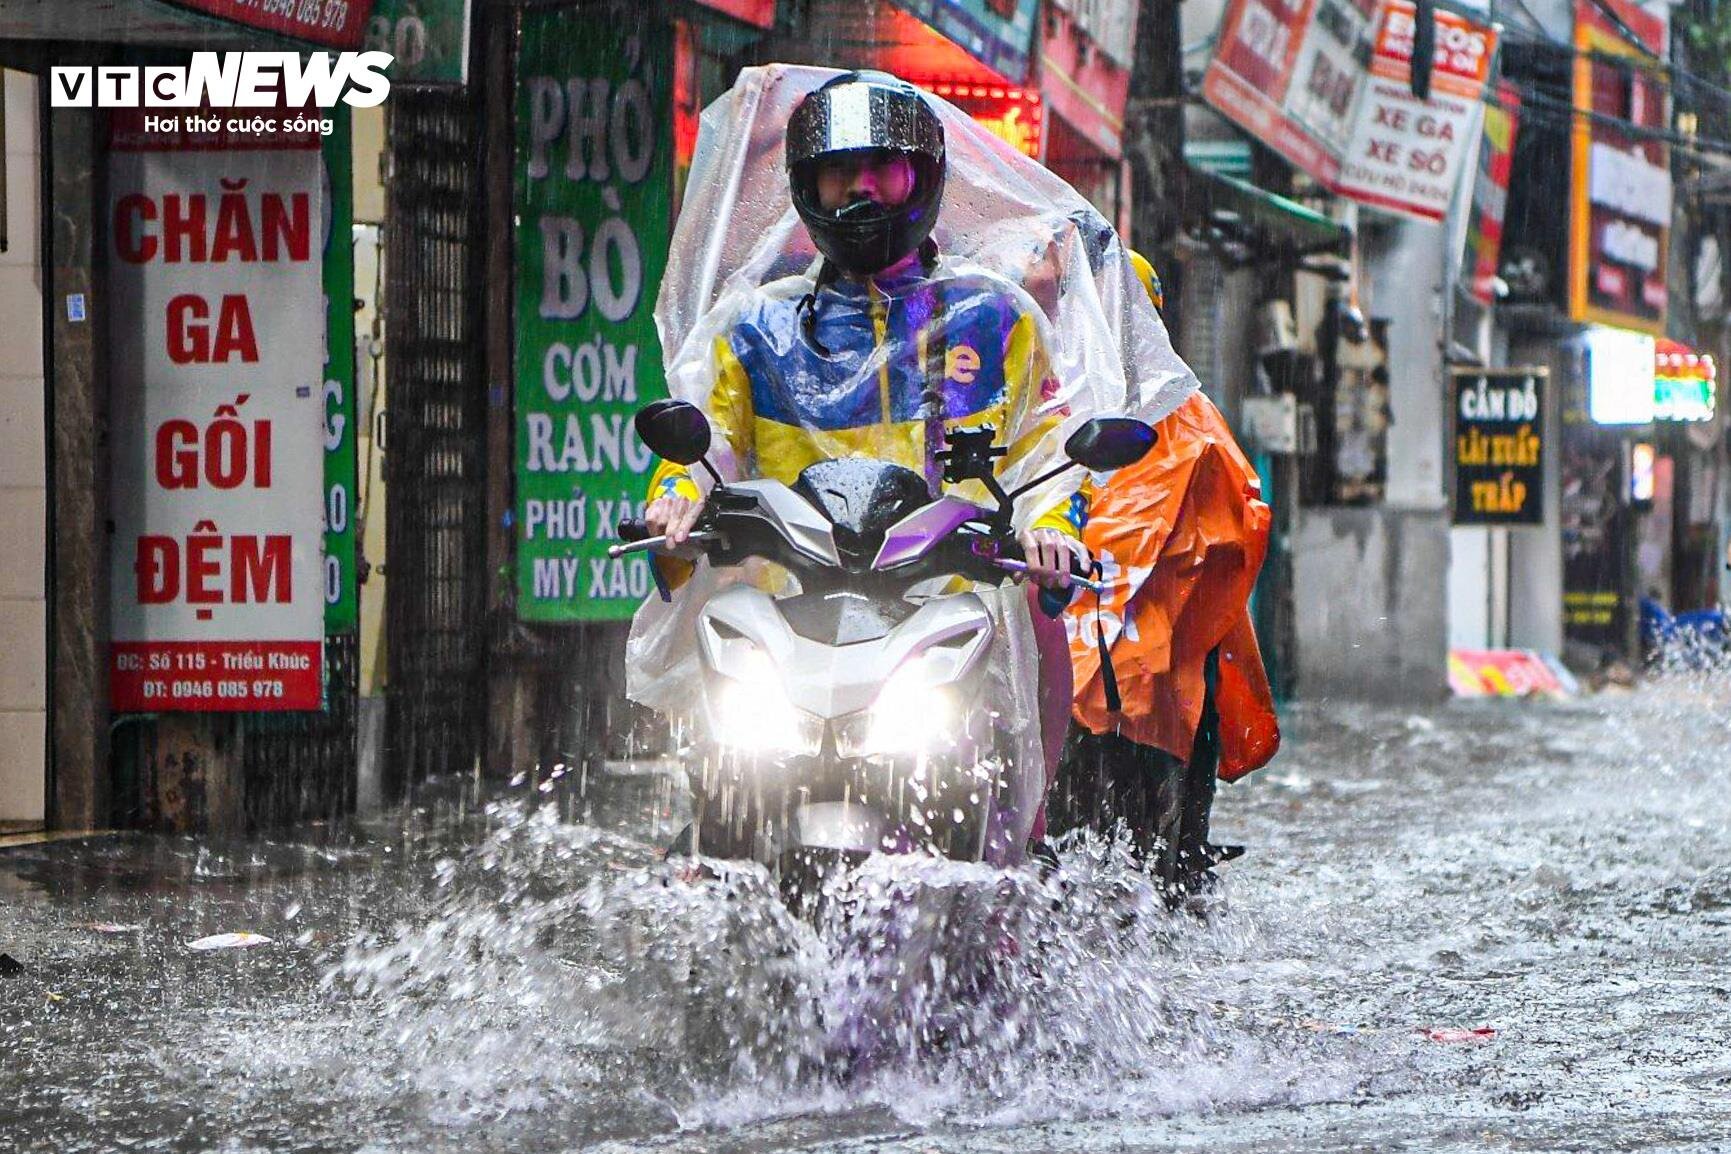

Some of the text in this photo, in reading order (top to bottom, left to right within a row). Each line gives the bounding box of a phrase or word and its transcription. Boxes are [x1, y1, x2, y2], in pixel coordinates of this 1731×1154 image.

[1373, 104, 1454, 142] XE GA
[113, 178, 311, 264] CHĂN
[538, 186, 642, 322] BÒ
[166, 293, 259, 365] GA
[543, 332, 638, 402] CƠM
[155, 393, 272, 489] GỐI
[525, 412, 651, 473] RANG
[525, 485, 587, 541] PHỞ
[134, 519, 293, 621] ĐỆM
[149, 649, 172, 671] Số
[176, 653, 206, 671] 115
[267, 650, 311, 671] Khúc
[172, 680, 213, 698] 0946
[217, 680, 248, 698] 085
[252, 680, 284, 698] 978
